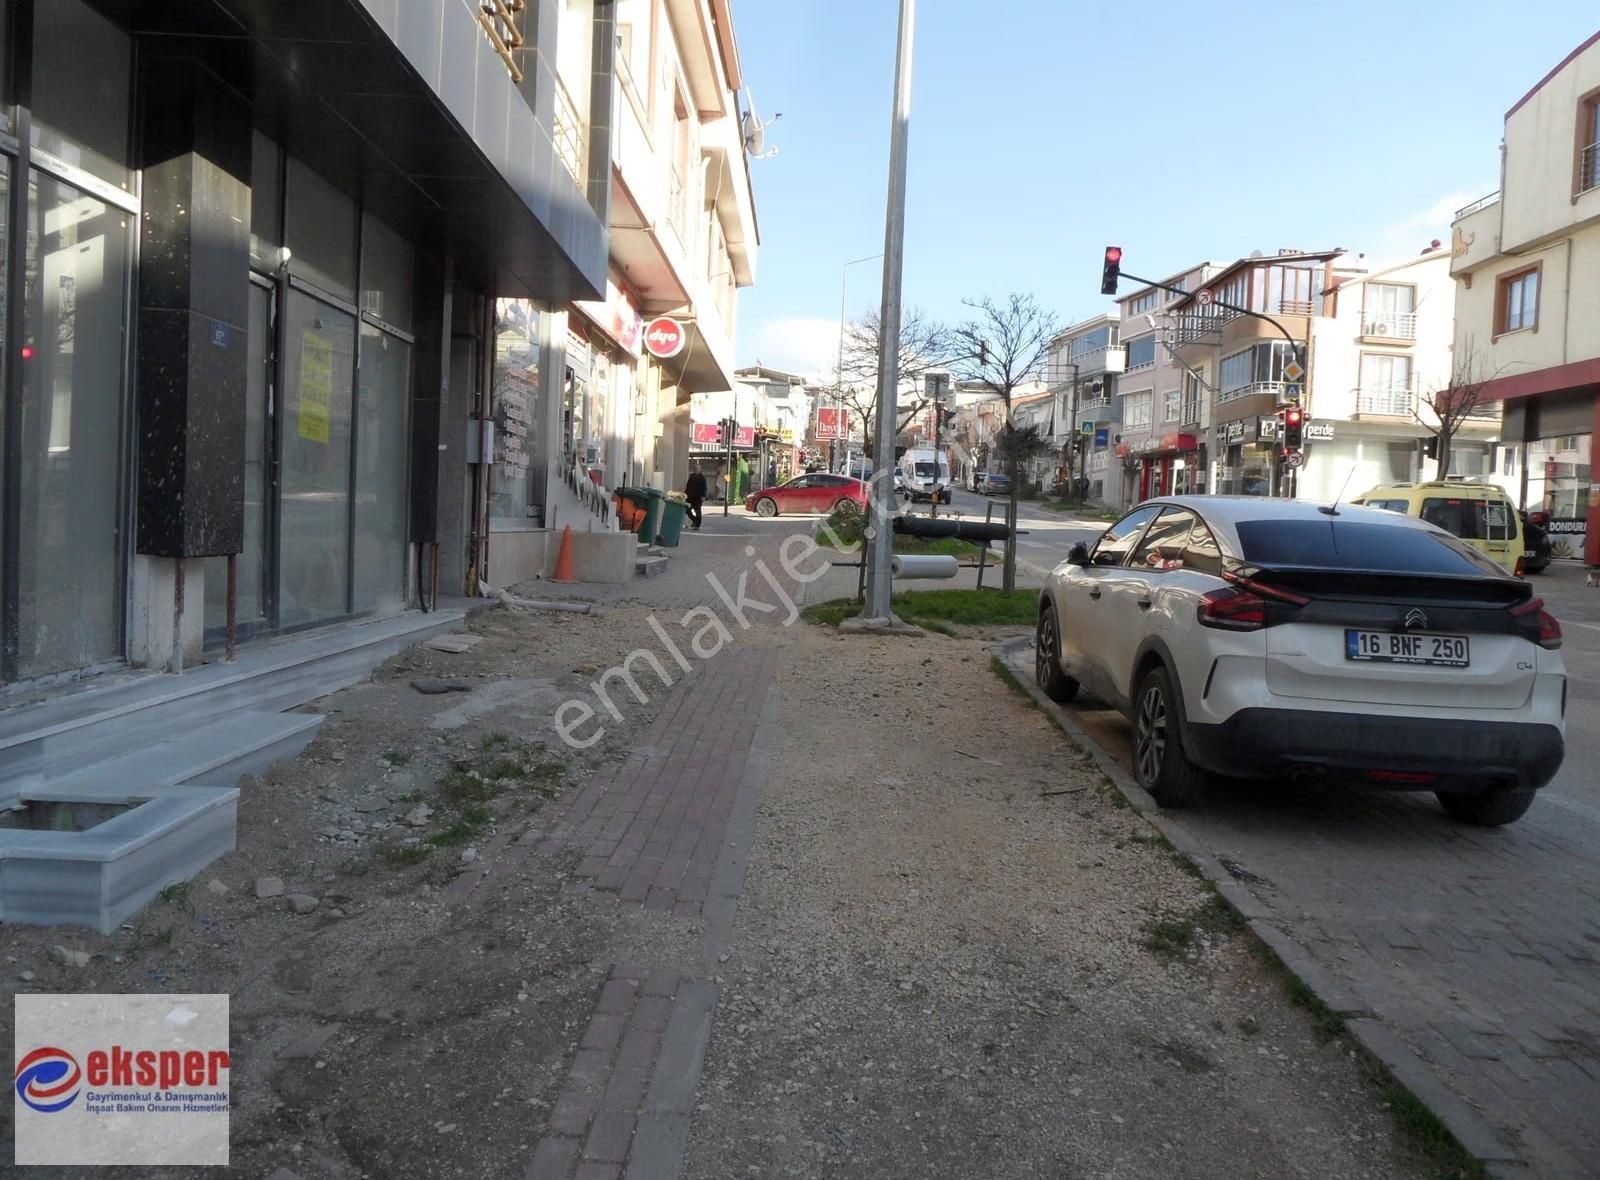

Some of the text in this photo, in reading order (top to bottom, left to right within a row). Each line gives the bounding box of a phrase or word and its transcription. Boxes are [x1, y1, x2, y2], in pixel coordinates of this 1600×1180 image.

[649, 328, 678, 344] dyo
[1307, 424, 1335, 438] perde
[1360, 634, 1464, 659] 16 BNF 250
